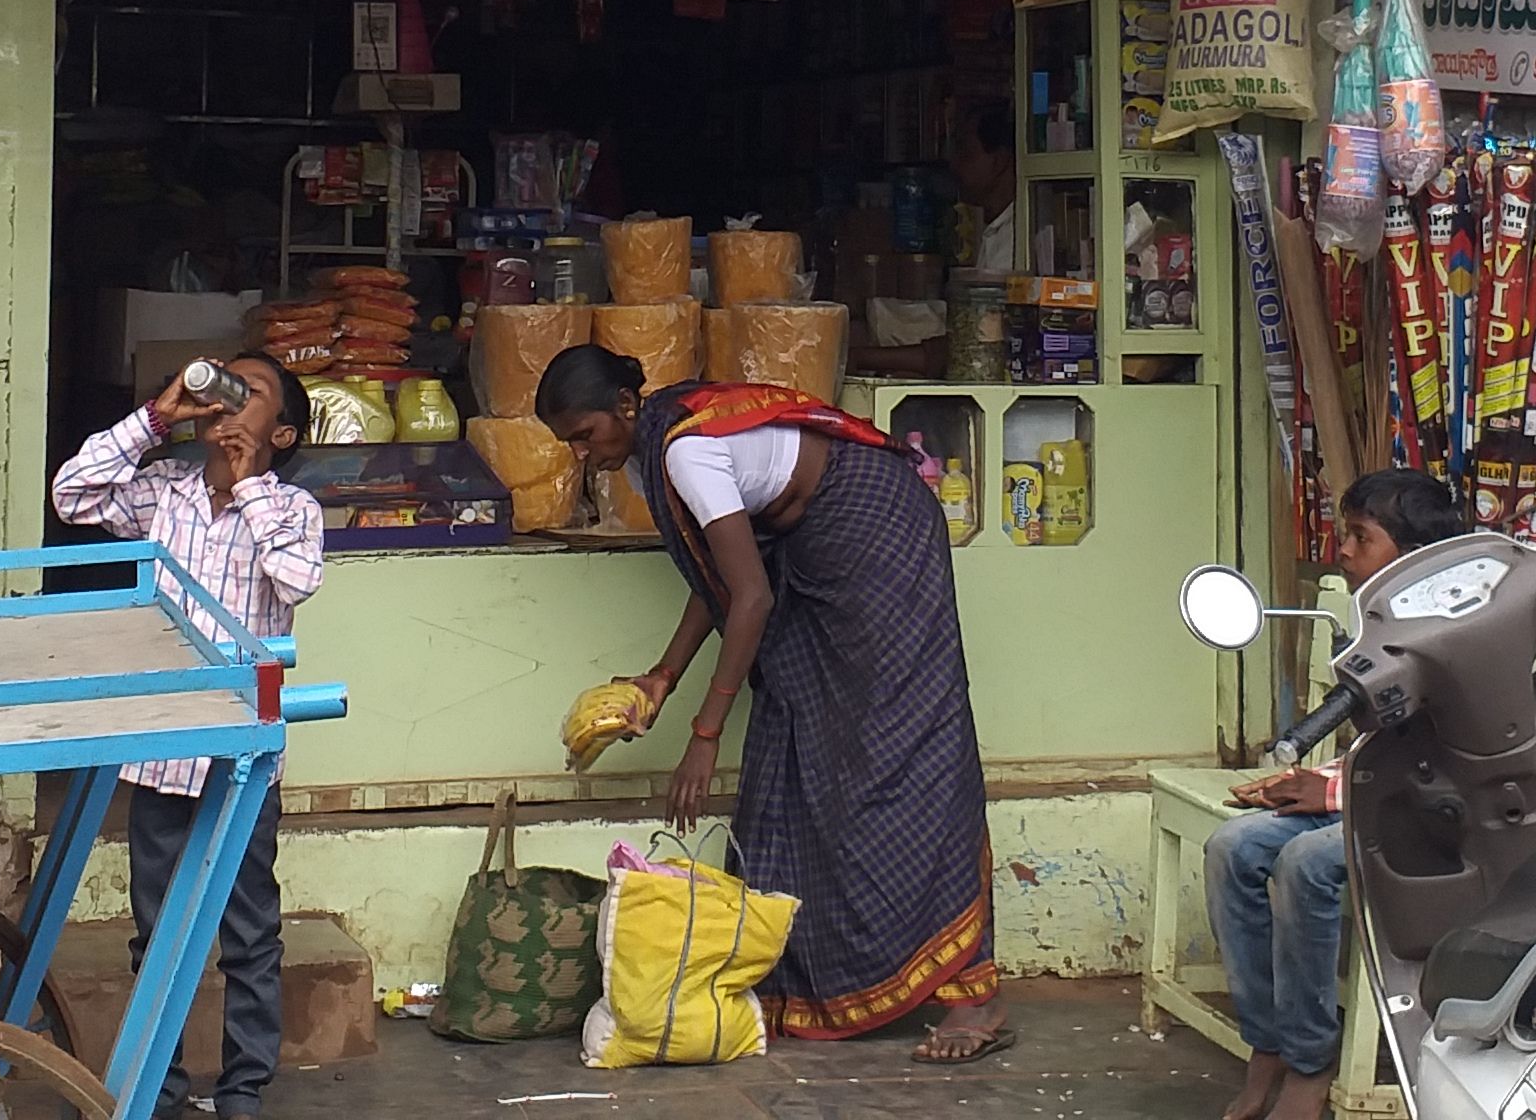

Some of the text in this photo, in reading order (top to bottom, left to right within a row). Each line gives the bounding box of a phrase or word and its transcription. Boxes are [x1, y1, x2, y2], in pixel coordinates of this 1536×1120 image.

[1169, 8, 1307, 50] ADAGOL
[1176, 44, 1267, 70] MURMURA
[1388, 239, 1434, 358] VIP
[1486, 239, 1522, 357] VIP
